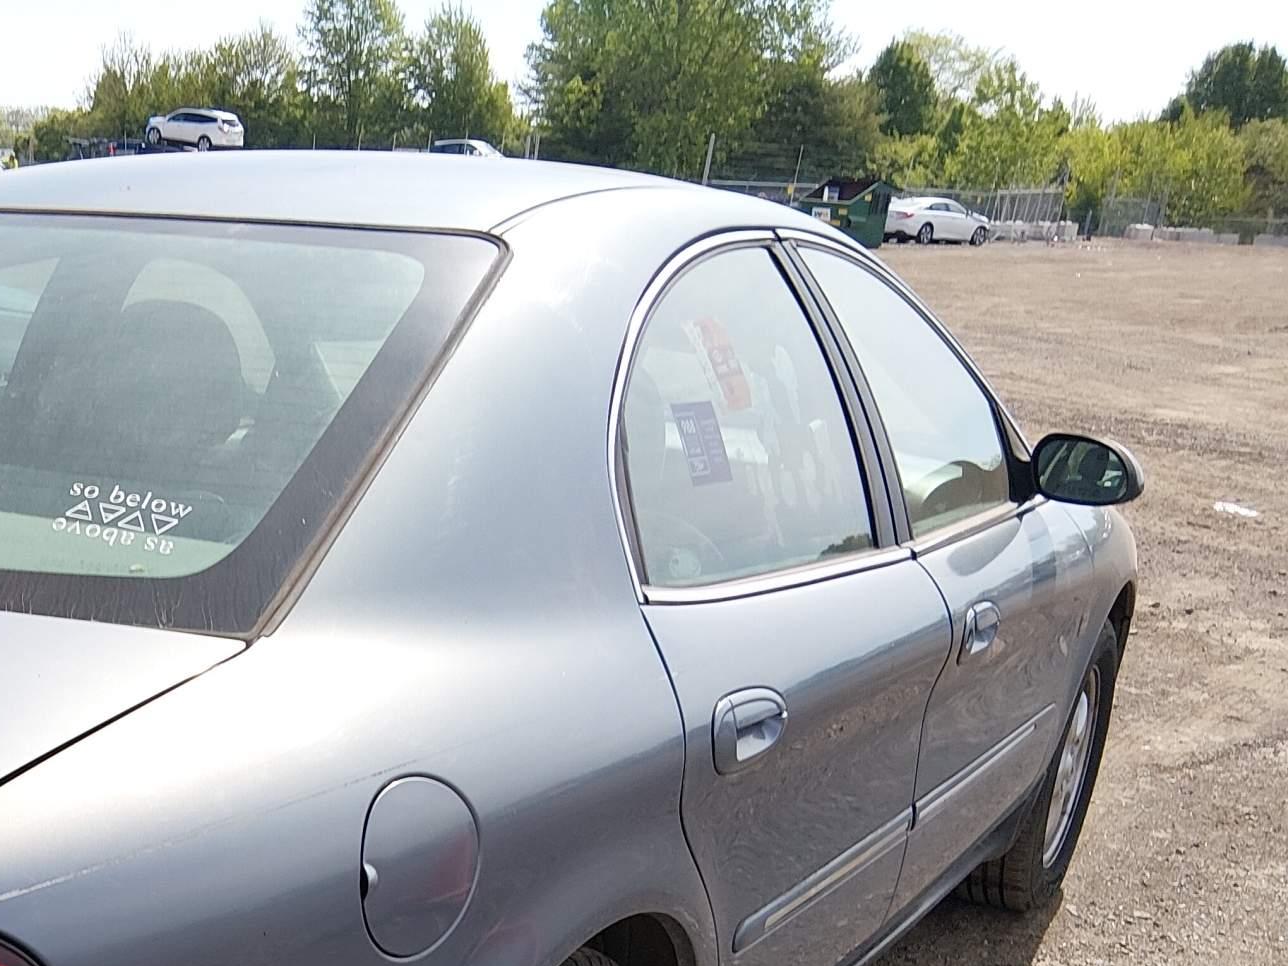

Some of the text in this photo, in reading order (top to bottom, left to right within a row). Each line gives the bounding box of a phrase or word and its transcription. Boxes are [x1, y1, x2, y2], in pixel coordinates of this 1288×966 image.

[69, 482, 193, 518] so below
[52, 517, 174, 555] as above
